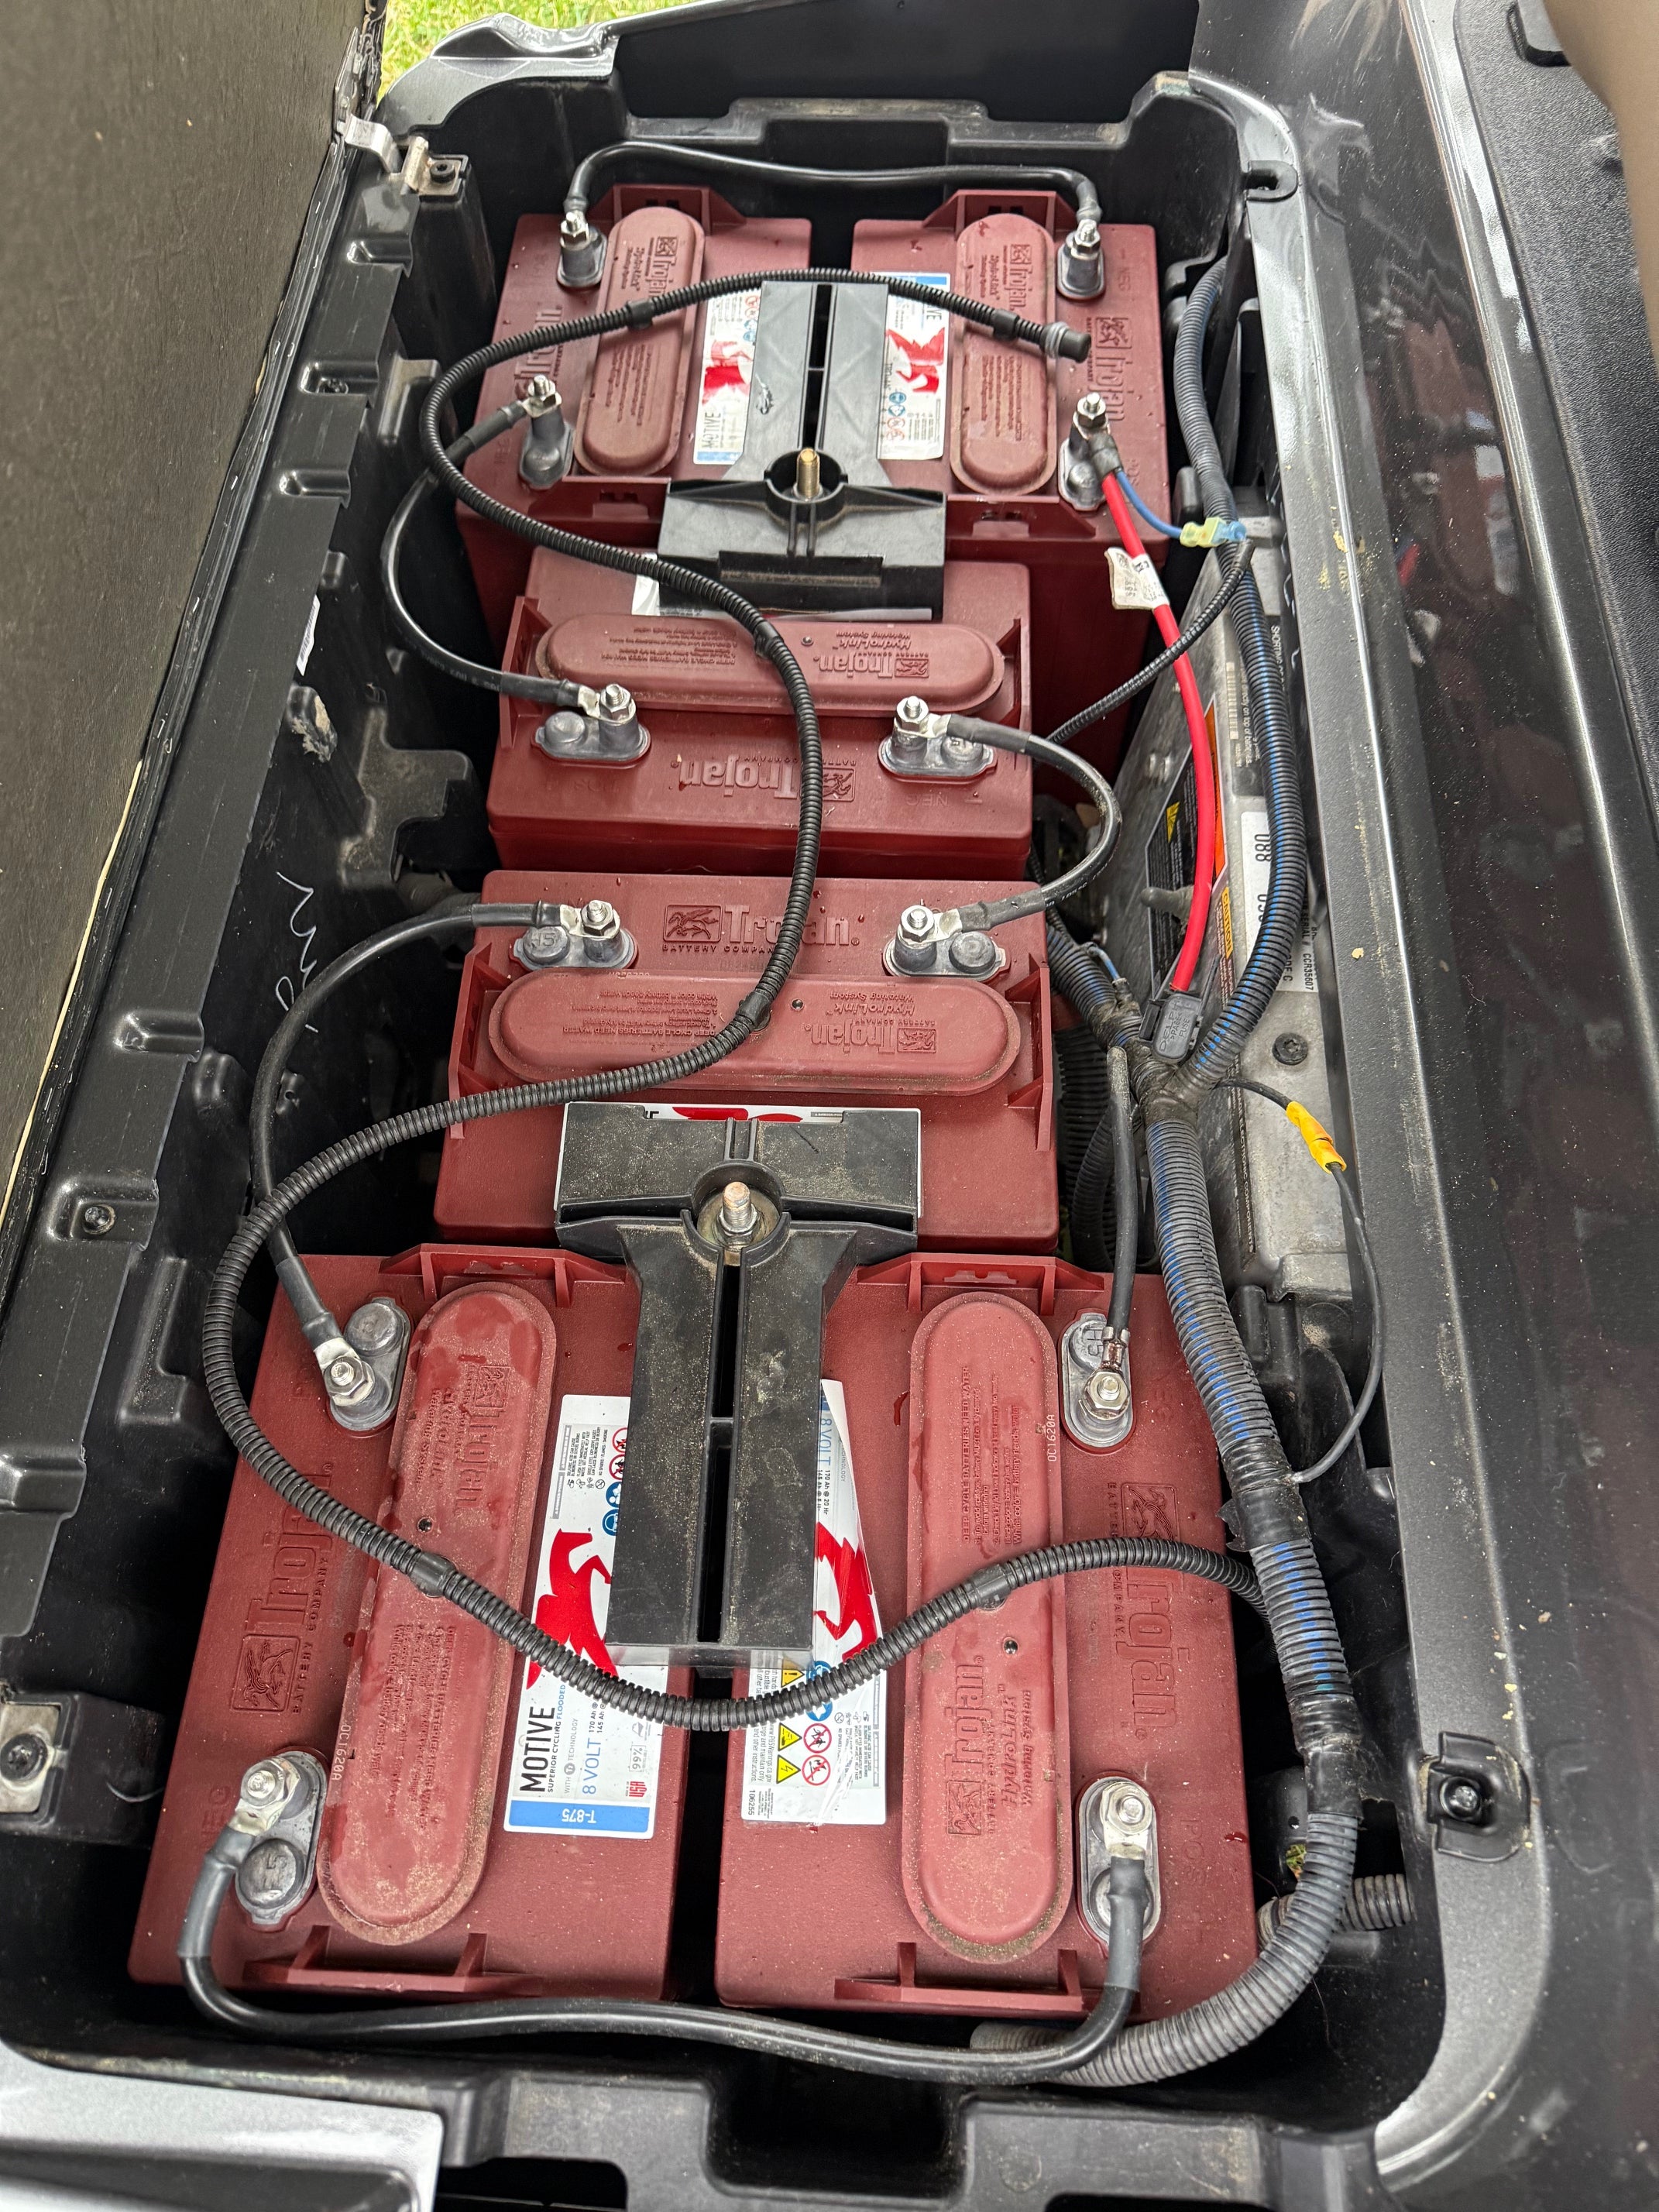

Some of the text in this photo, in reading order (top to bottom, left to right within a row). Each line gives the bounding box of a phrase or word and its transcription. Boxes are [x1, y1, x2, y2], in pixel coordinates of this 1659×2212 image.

[1005, 267, 1033, 308] Trojan
[1087, 356, 1135, 421] Trojan
[701, 412, 721, 448] MOTIVE
[818, 651, 893, 679] Trojan
[1242, 716, 1252, 726] top
[1243, 707, 1251, 716] on
[679, 754, 798, 801] Trojan
[724, 904, 850, 946] Troan
[1222, 893, 1232, 953] CAUTION
[663, 944, 775, 954] BATTERY COMPAN
[1304, 953, 1314, 991] CCR35607
[811, 1019, 896, 1055] Trojan
[1179, 1018, 1190, 1037] FUSE
[1239, 1117, 1249, 1180] ELECTRONIC
[1244, 1181, 1254, 1253] COMPONENTS
[961, 1366, 970, 1542] DEEP CYCLE BATTERIES NEED WATER
[1012, 1428, 1020, 1455] needs
[454, 1410, 506, 1510] Trojan
[1012, 1456, 1021, 1486] battery
[823, 1481, 831, 1489] Ah
[823, 1498, 830, 1506] 20
[1013, 1518, 1022, 1544] White
[245, 1474, 333, 1630] Troja
[1107, 1482, 1125, 1636] BATTER OMPANY
[291, 1558, 329, 1715] BATTERY COMPANY
[589, 1710, 597, 1719] Ah
[597, 1711, 605, 1720] Ah
[519, 1706, 555, 1792] MOTIVE
[547, 1684, 566, 1793] SUPERIOR CYCLING FLOODED
[566, 1718, 578, 1761] TECHNOLOGY
[1021, 1690, 1035, 1807] Watering System
[582, 1737, 602, 1795] 8 VOLT
[631, 1747, 643, 1770] 99%
[628, 1781, 647, 1798] USA
[747, 1789, 756, 1815] 106255
[562, 1808, 597, 1824] T-875
